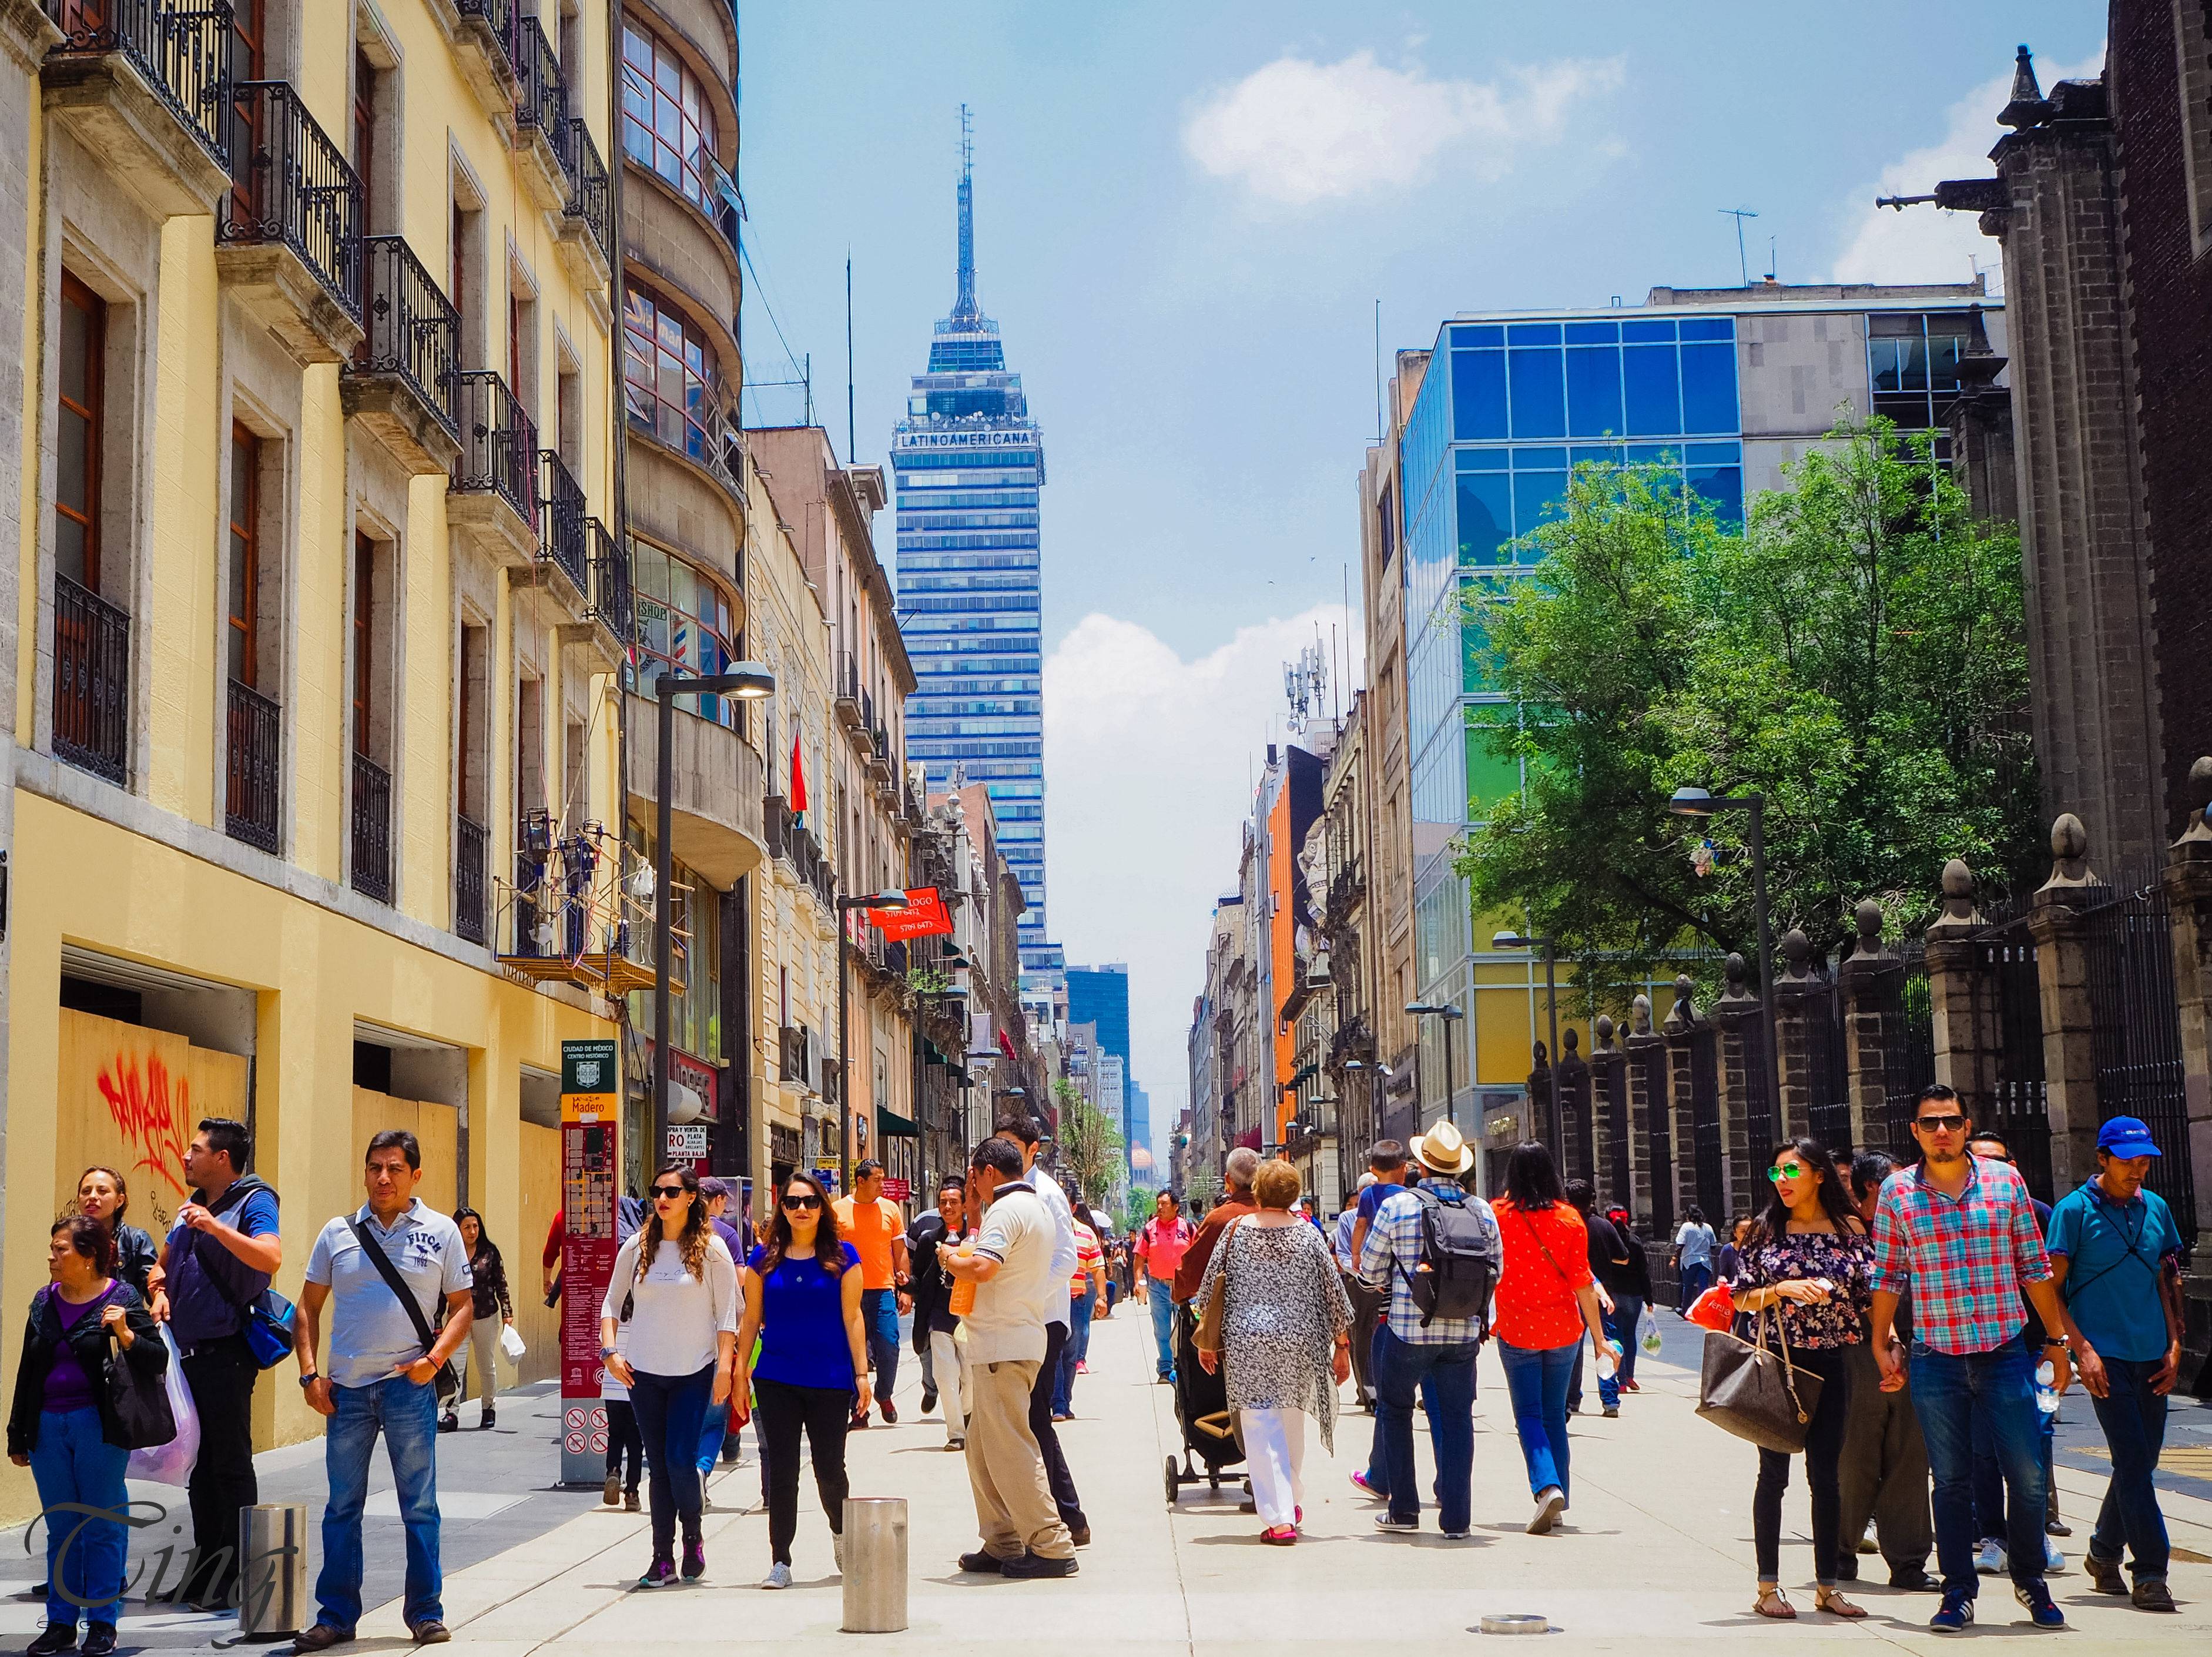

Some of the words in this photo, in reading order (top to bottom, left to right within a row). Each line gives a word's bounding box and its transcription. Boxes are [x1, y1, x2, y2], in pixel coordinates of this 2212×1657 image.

[902, 433, 1029, 447] LATINOAMERICANA
[572, 1102, 604, 1112] Madero
[406, 1232, 442, 1253] FITCH
[414, 1257, 427, 1267] 1892
